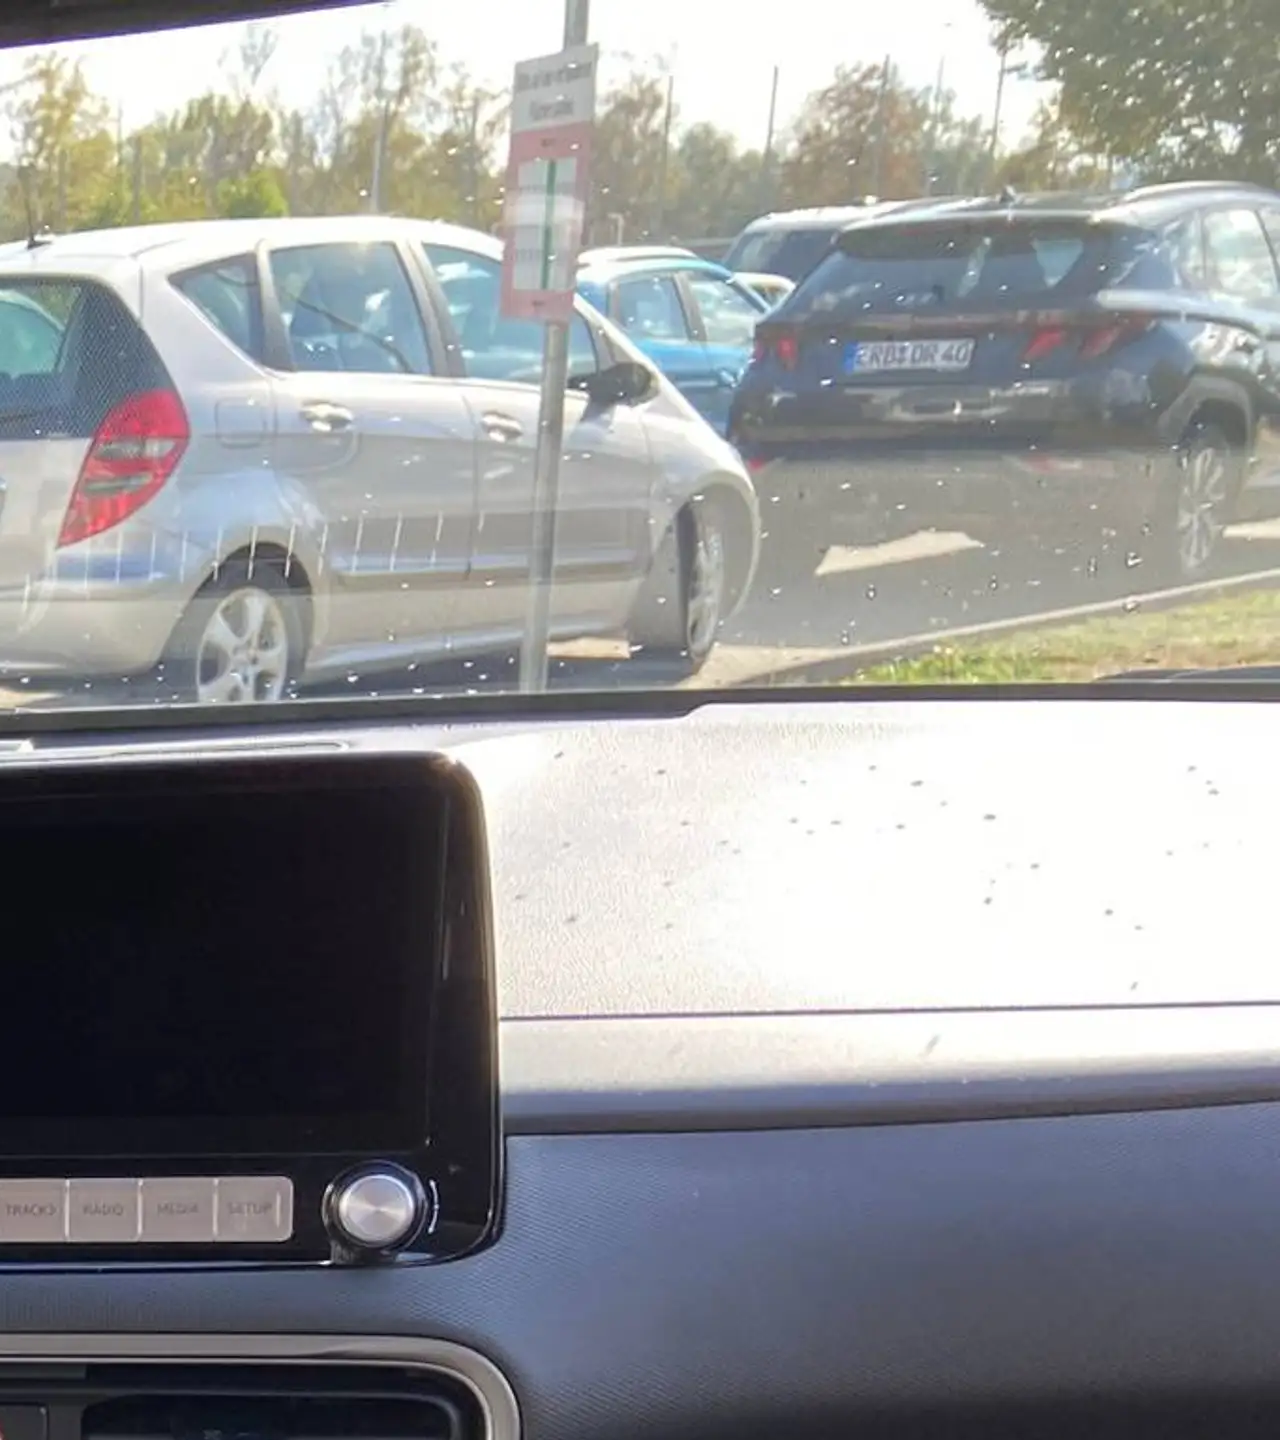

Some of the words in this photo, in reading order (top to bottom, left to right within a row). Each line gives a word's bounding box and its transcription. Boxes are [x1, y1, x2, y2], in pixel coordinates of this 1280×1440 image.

[82, 1203, 124, 1217] RADIO
[156, 1202, 199, 1216] MEDIA
[227, 1202, 273, 1216] SETUP
